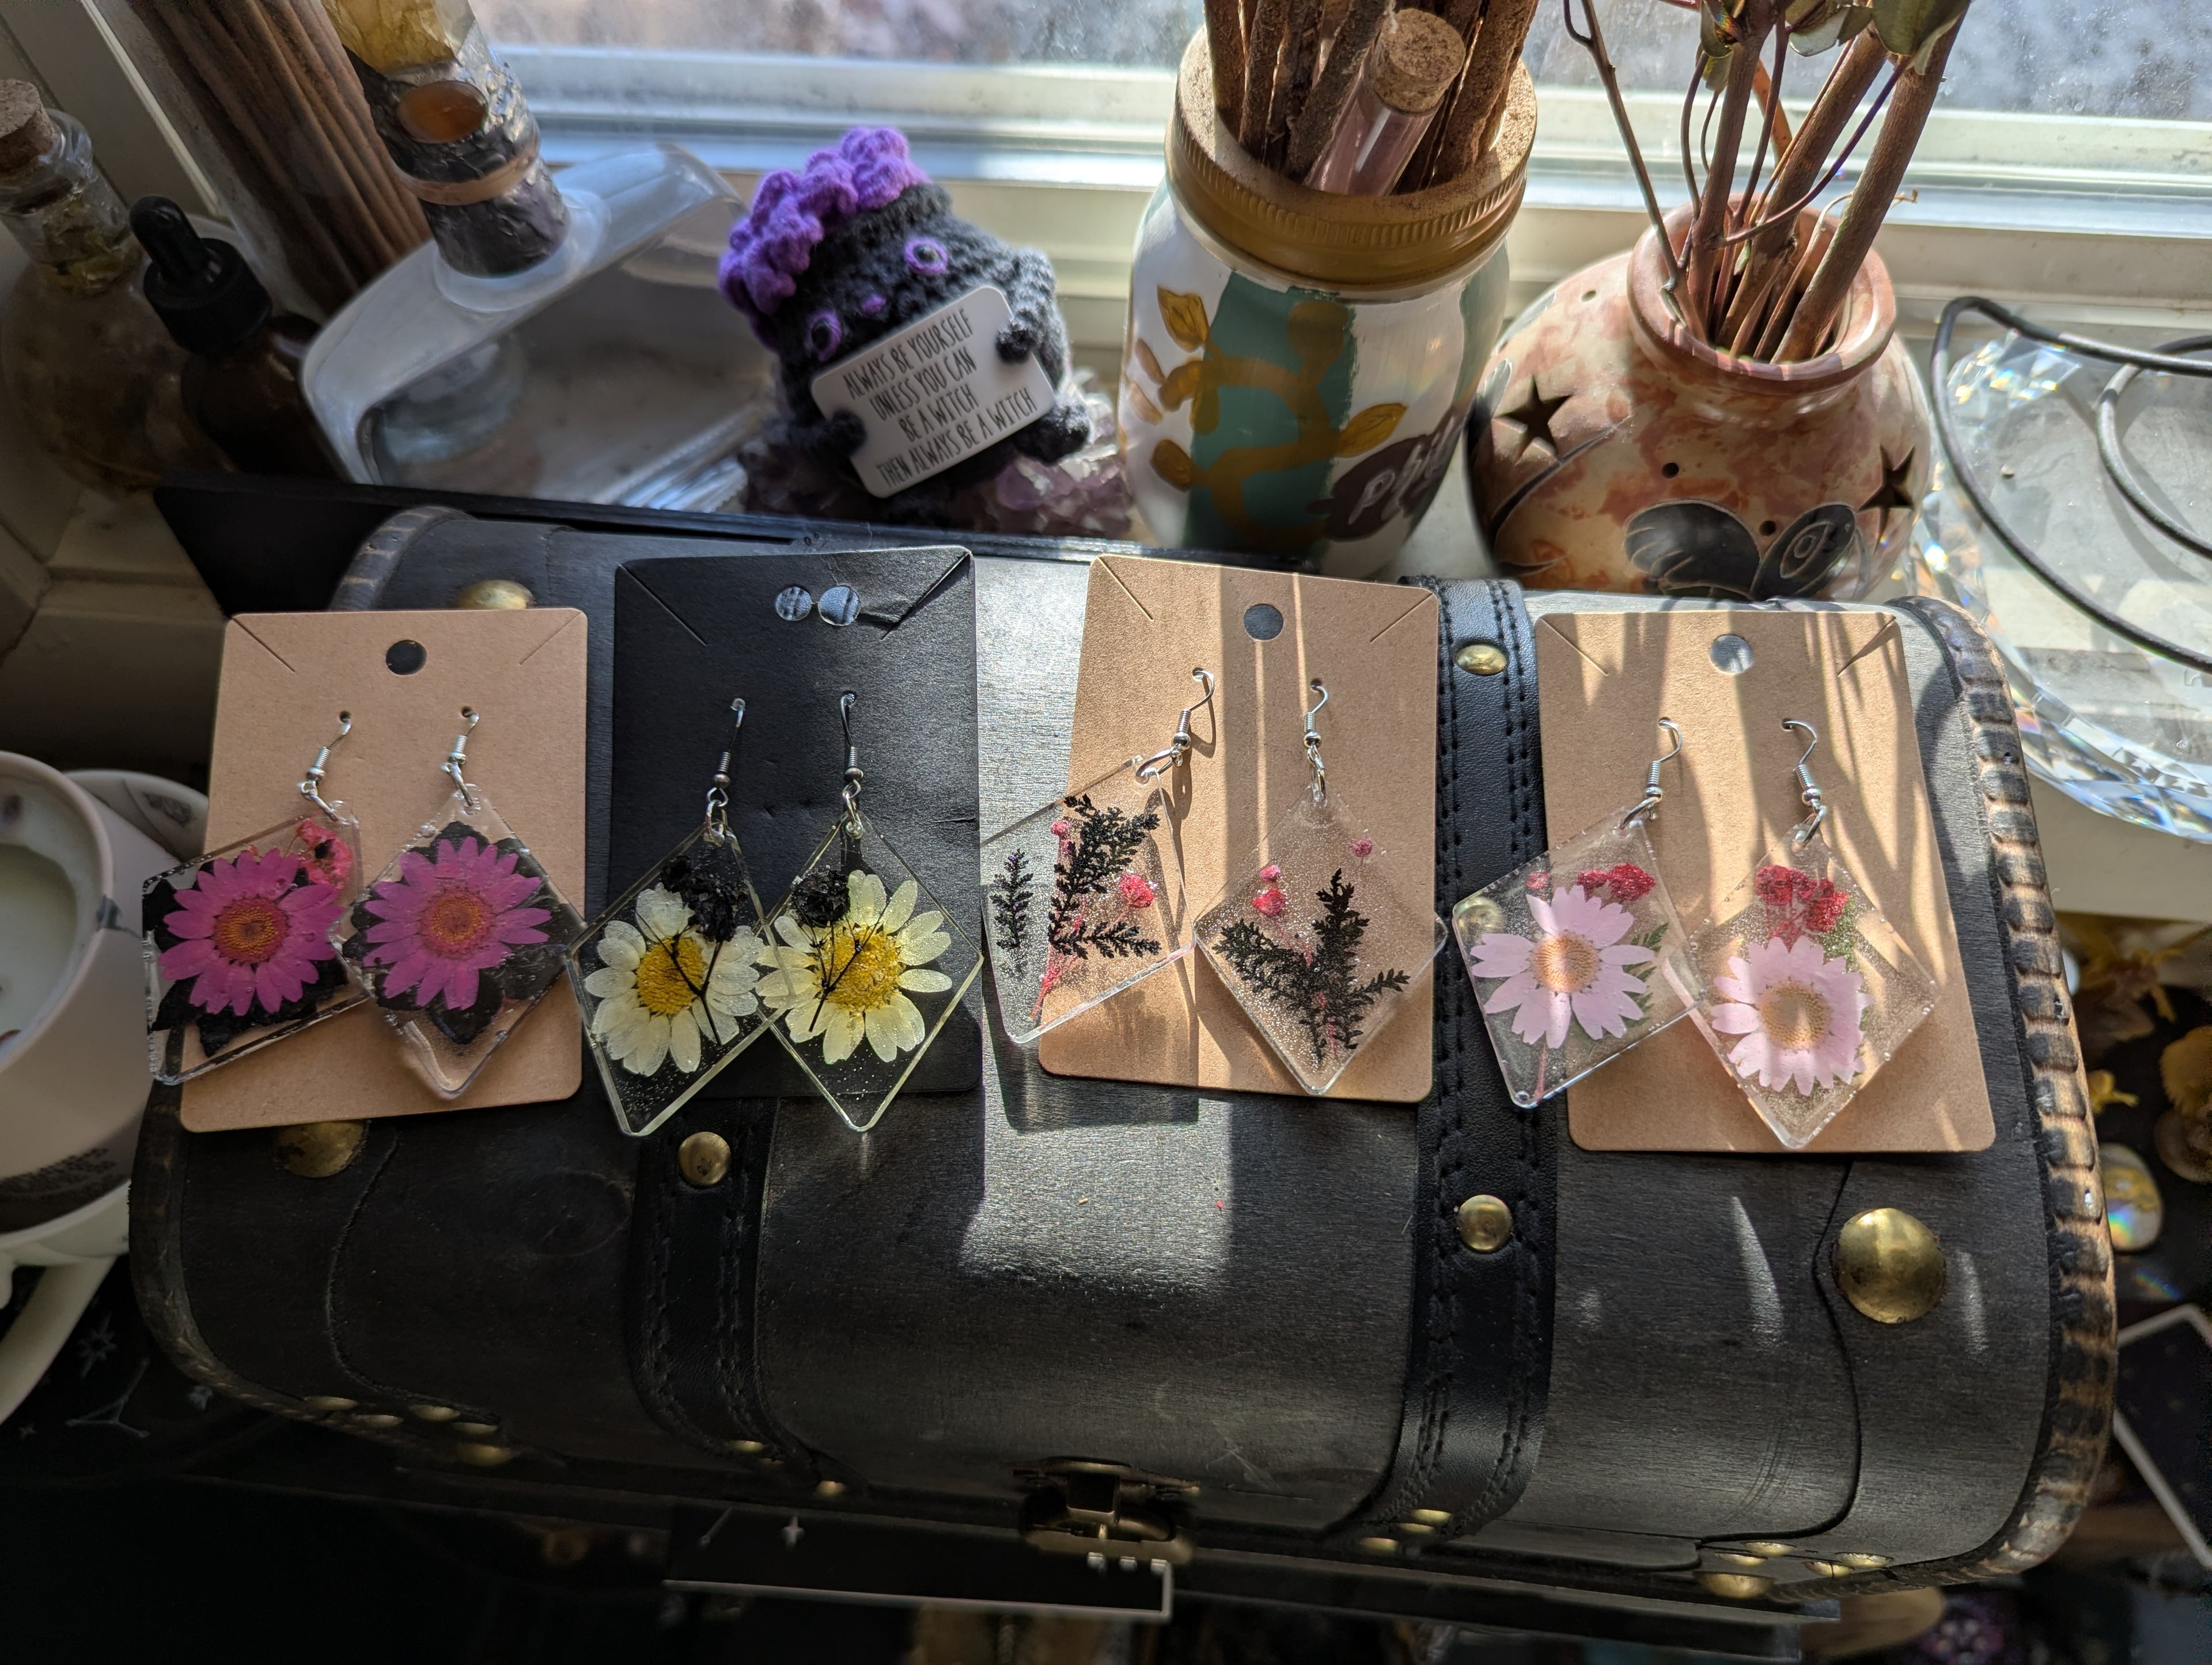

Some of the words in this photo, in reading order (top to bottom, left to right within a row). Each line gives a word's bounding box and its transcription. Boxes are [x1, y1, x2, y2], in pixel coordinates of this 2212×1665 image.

[843, 354, 895, 400] ALWAYS
[890, 344, 914, 374] BE
[907, 309, 973, 363] YOURSELF
[869, 378, 920, 421] UNLESS
[914, 362, 947, 397] YOU
[944, 346, 976, 382] CAN
[876, 453, 912, 487] THEN
[909, 430, 960, 475] ALWAYS
[957, 421, 980, 449] BE
[976, 414, 993, 439] A
[986, 388, 1037, 431] WITCH
[899, 415, 922, 442] BE
[918, 409, 934, 435] A
[927, 384, 979, 427] WITCH
